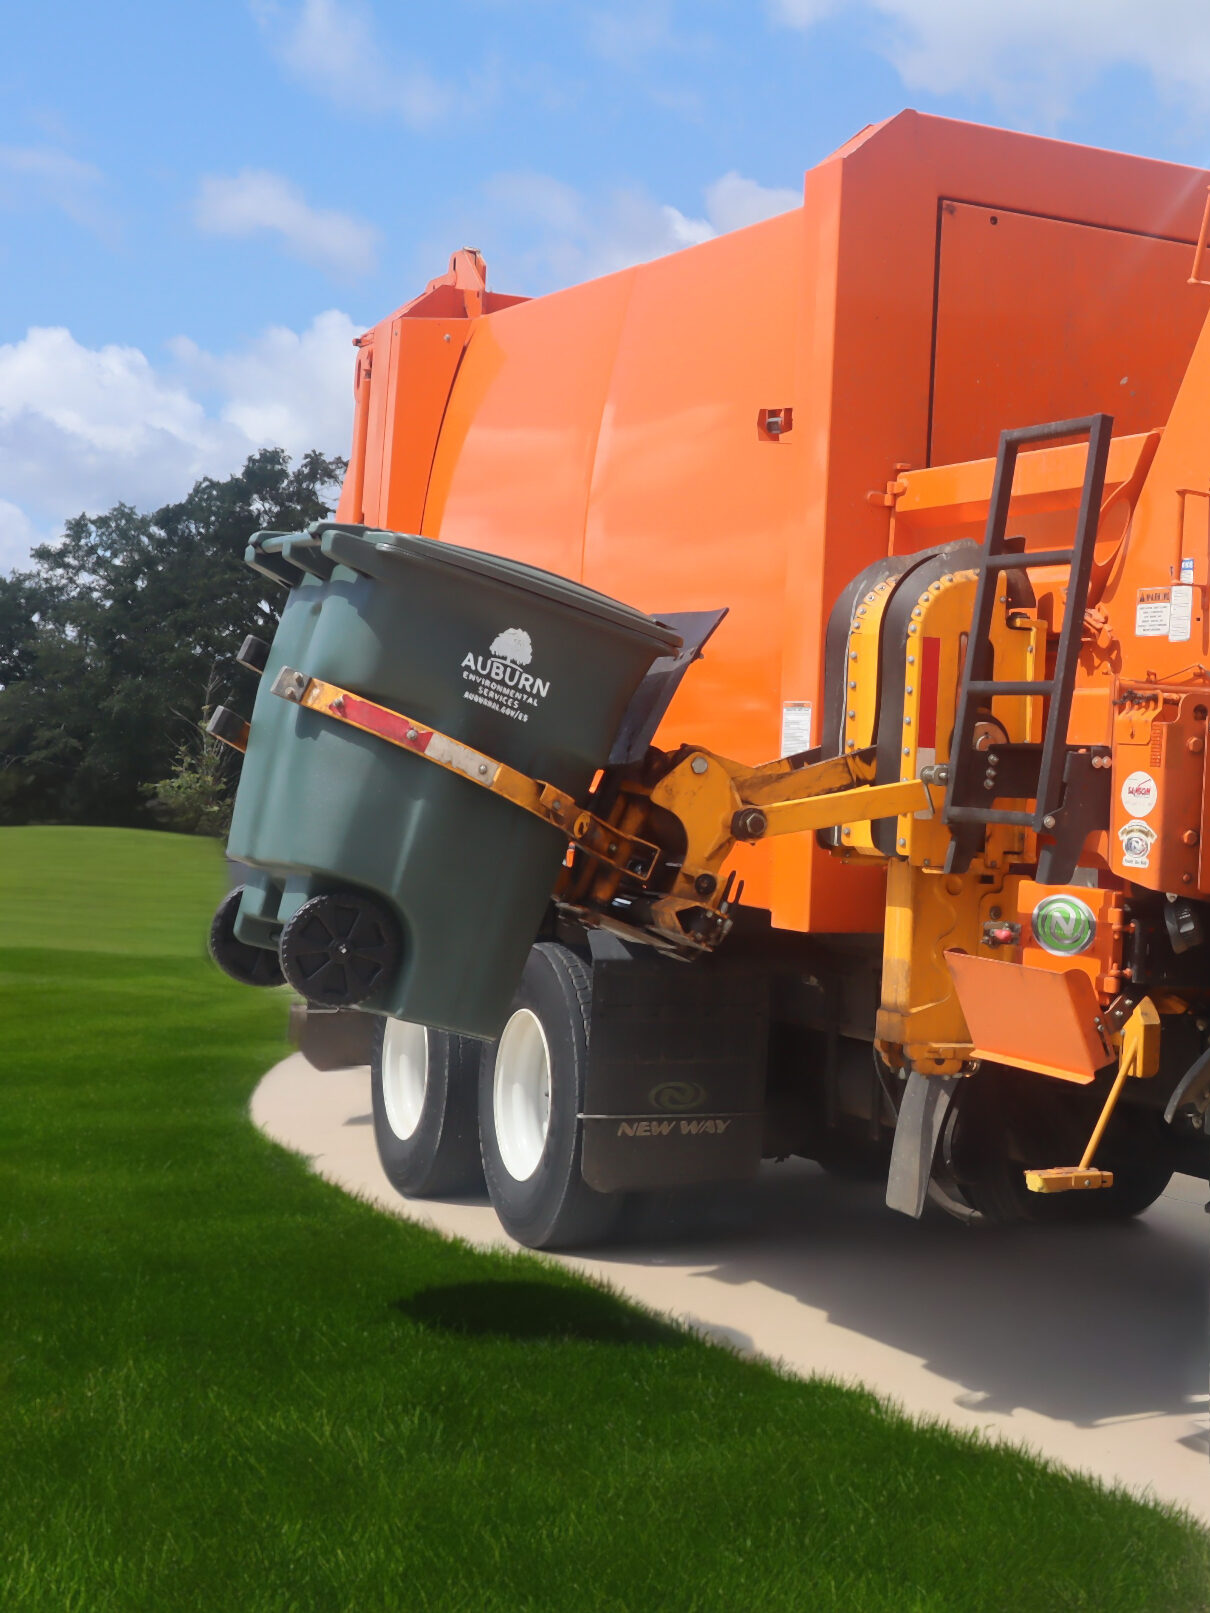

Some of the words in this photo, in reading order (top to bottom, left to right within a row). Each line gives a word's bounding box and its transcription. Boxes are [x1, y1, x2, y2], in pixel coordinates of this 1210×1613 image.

[461, 651, 551, 698] AUBURN
[462, 670, 538, 707] ENVIRONMENTAL
[478, 685, 520, 709] SERVICES
[617, 1120, 676, 1137] NEW
[679, 1119, 732, 1135] WAY
